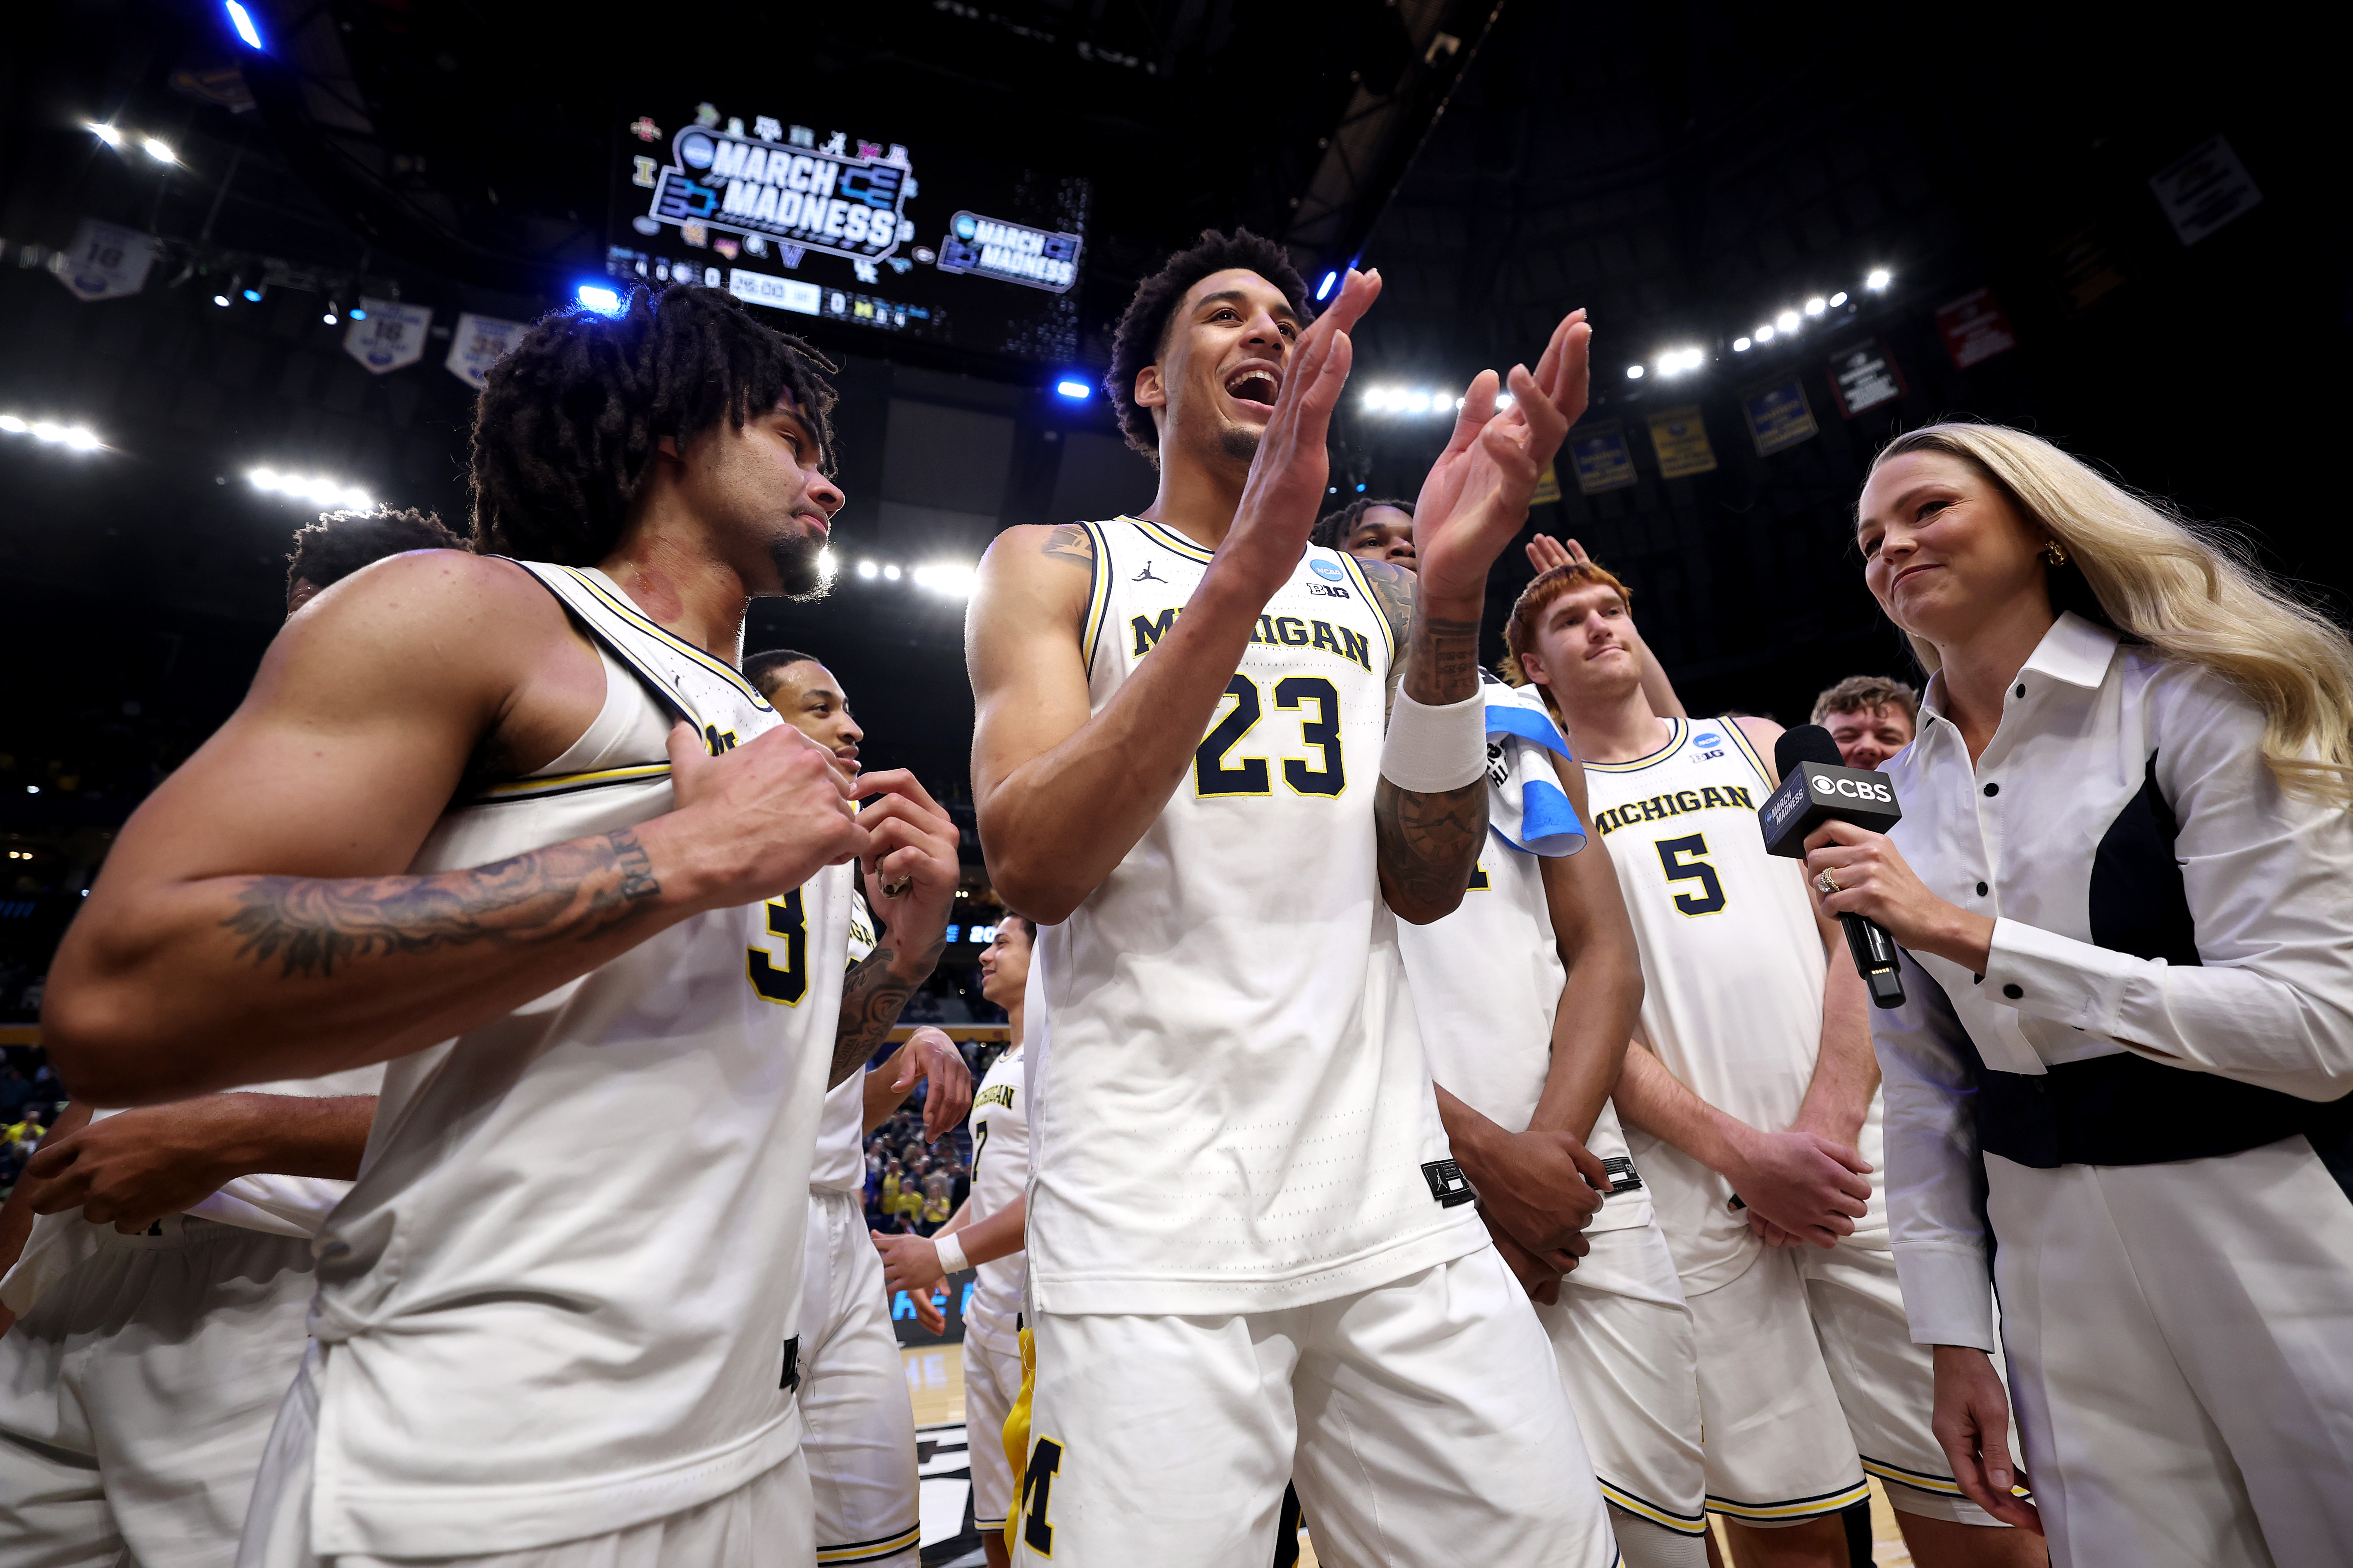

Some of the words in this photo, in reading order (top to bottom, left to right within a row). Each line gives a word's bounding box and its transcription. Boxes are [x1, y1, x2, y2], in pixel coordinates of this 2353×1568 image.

[710, 139, 839, 197] MARCH
[721, 178, 897, 247] MADNESS
[973, 220, 1046, 257] MARCH
[980, 244, 1074, 285] MADNESS
[830, 292, 846, 314] 0
[1130, 606, 1373, 675] MIGAN
[1194, 672, 1348, 800] 23
[1771, 789, 1792, 819] MARCH
[1776, 788, 1803, 825] MADNESS
[1836, 779, 1892, 803] CBS
[1652, 832, 1729, 918] 5
[747, 885, 808, 1007] 3
[972, 1119, 987, 1184] 7
